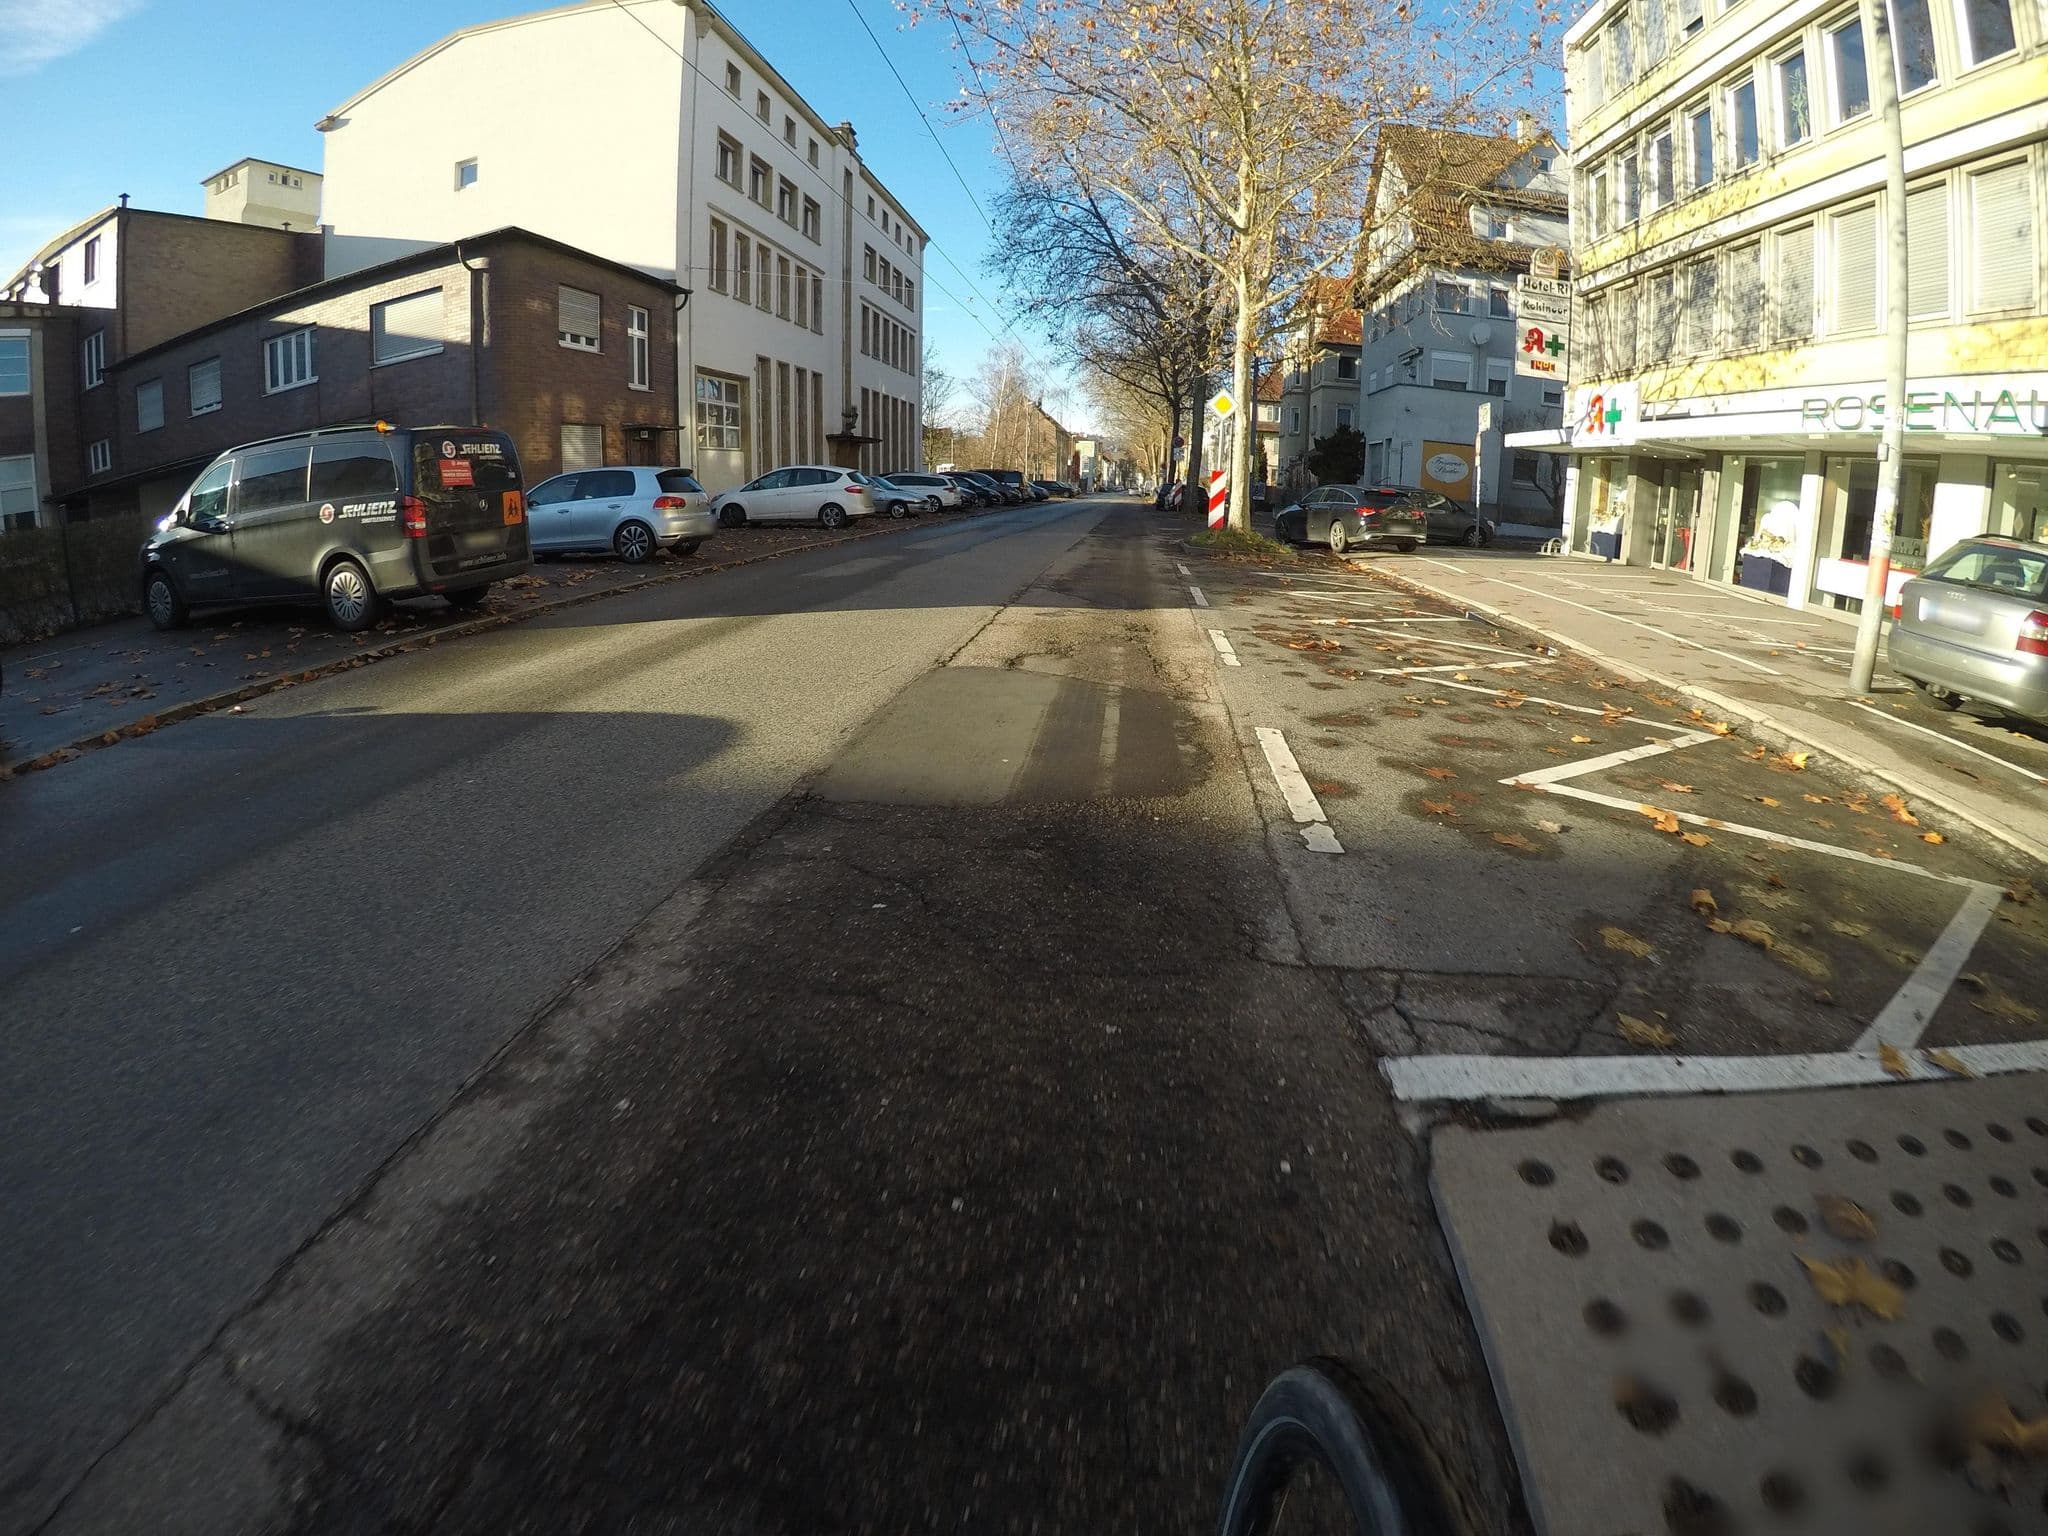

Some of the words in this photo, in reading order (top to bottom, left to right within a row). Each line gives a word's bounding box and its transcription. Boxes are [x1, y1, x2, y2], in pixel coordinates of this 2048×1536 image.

[1523, 299, 1568, 314] Kohinoor
[460, 443, 502, 455] SCHLIENZ
[338, 500, 397, 519] SCHLIENZ
